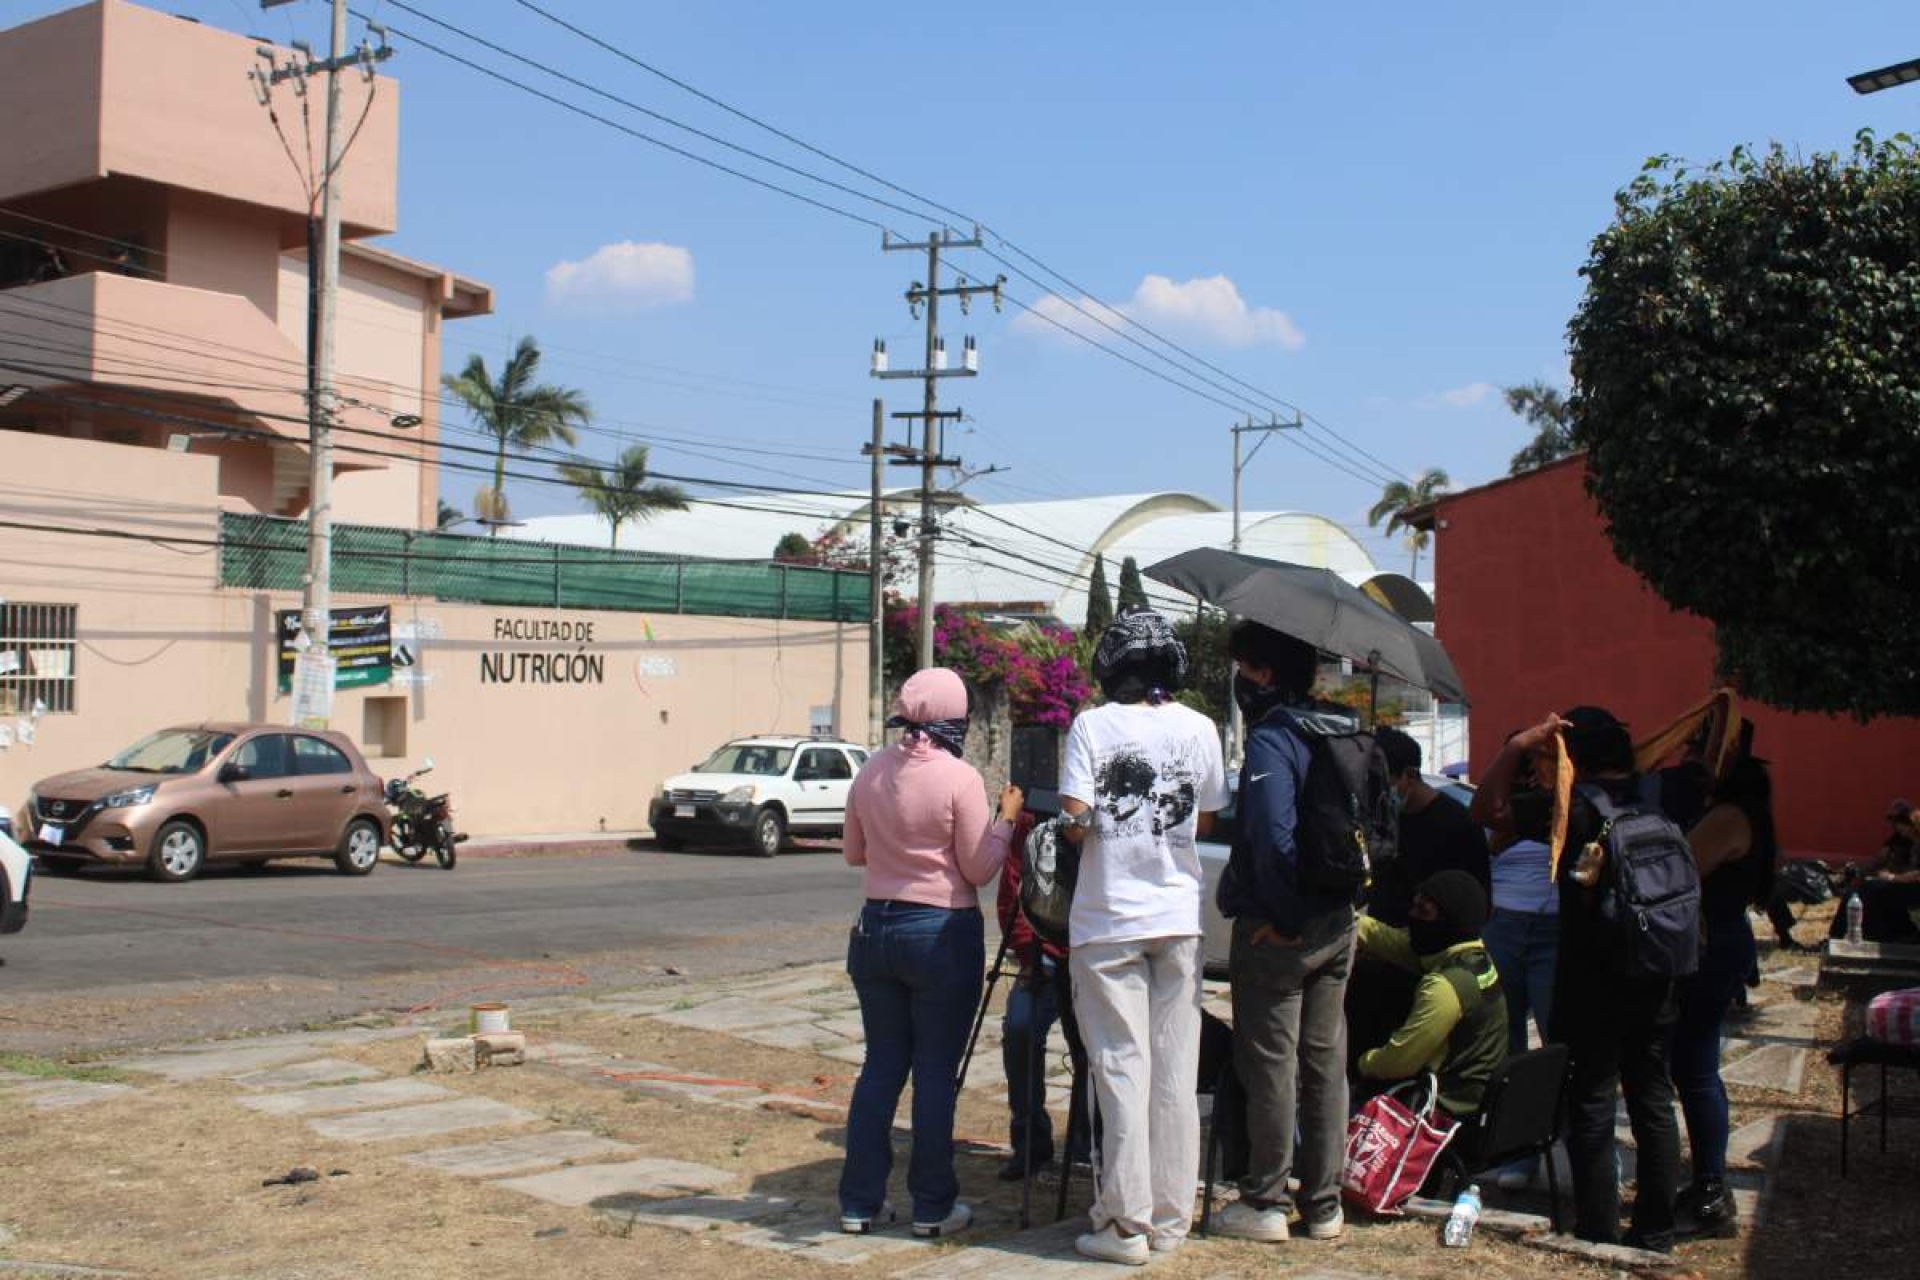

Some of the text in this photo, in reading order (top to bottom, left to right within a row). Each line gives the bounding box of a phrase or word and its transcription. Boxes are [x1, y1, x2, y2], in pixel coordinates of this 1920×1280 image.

[494, 618, 595, 642] FACULTAD DE
[480, 646, 604, 684] NUTRICIÓN
